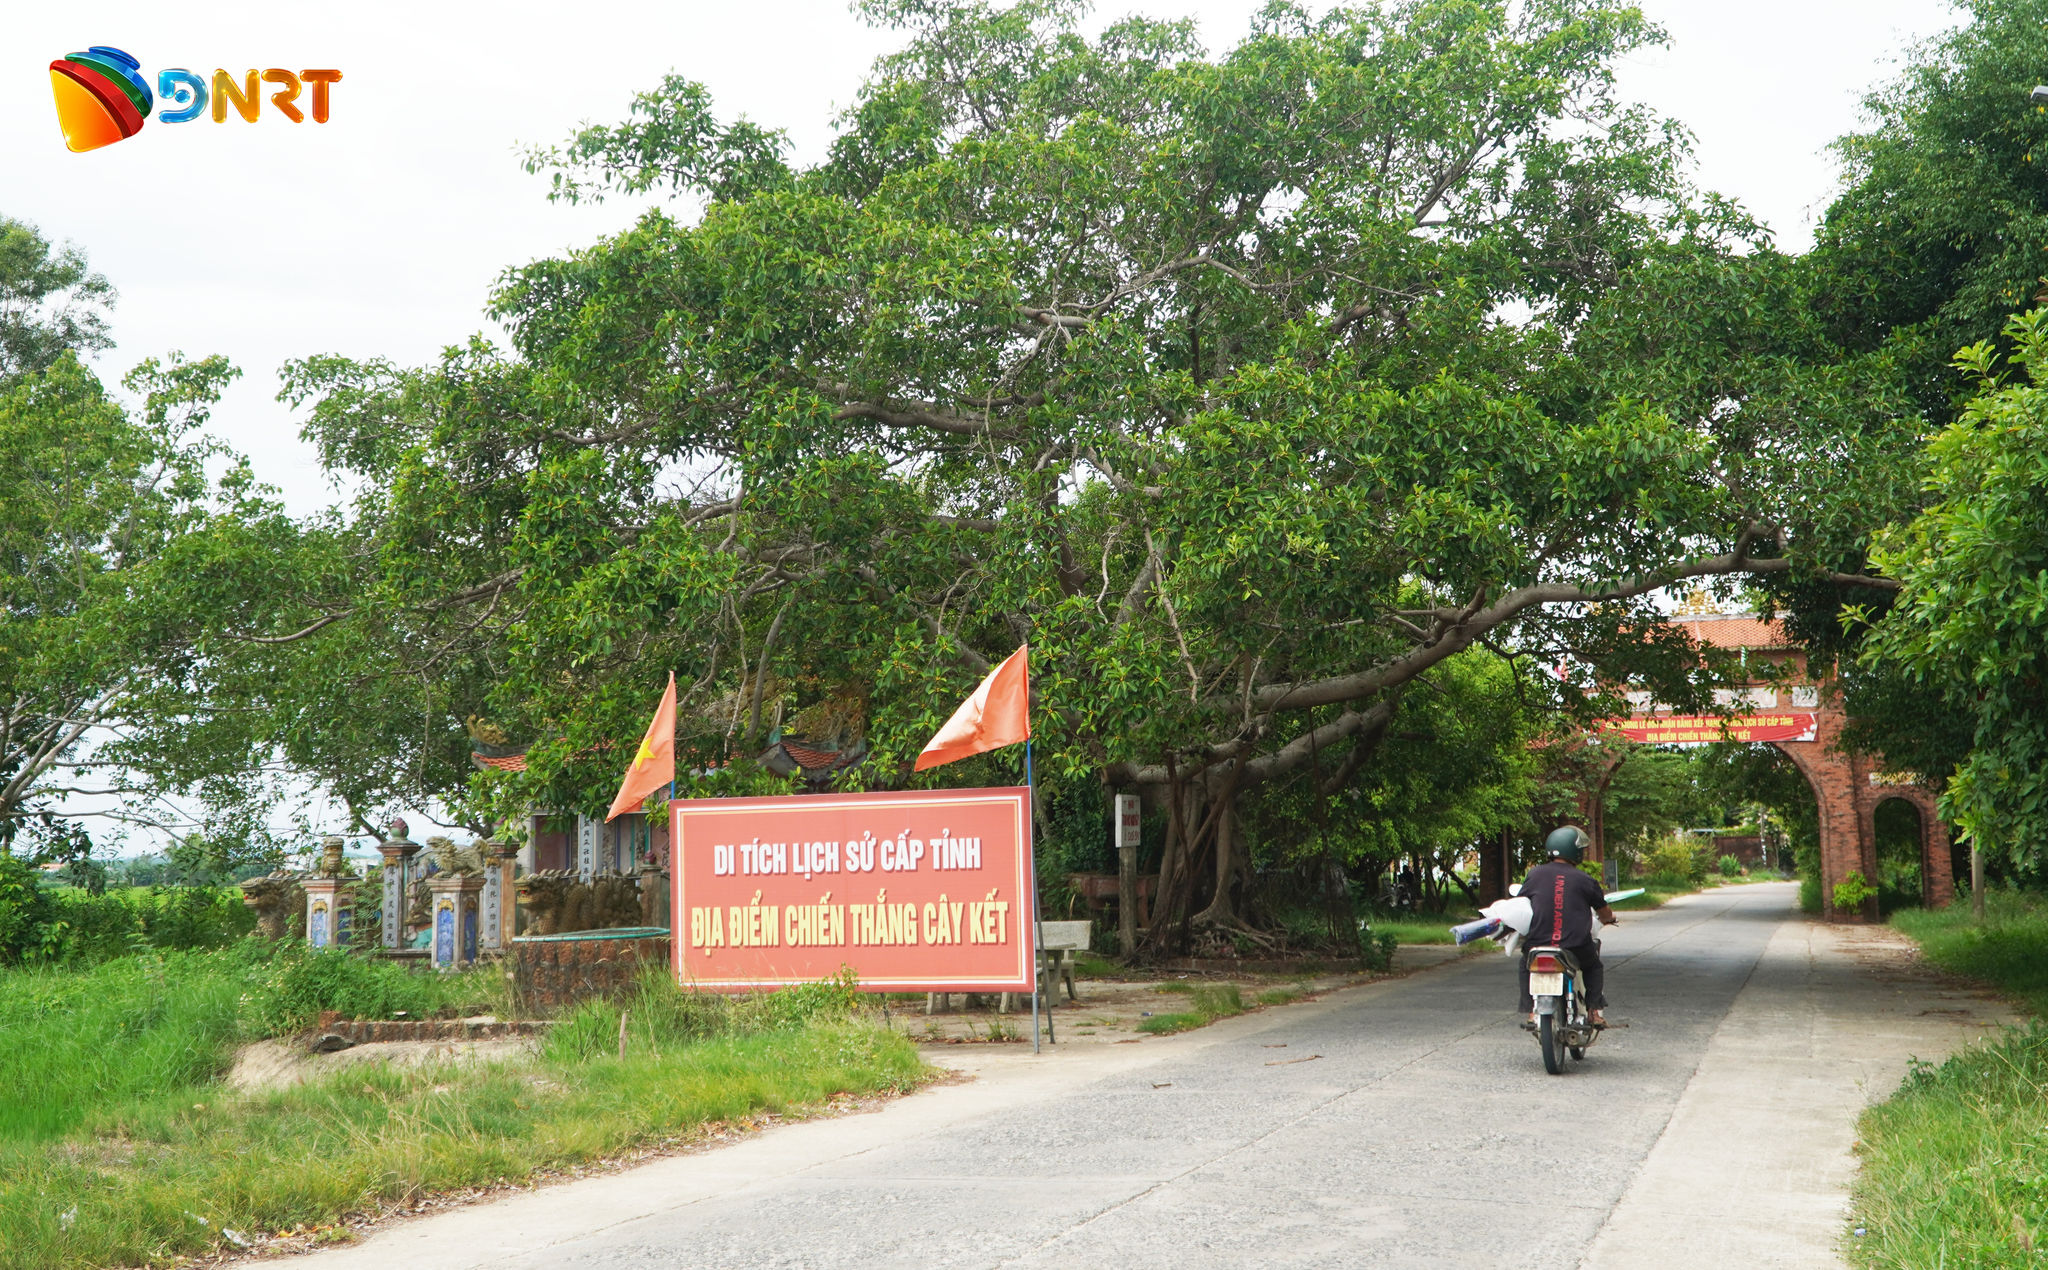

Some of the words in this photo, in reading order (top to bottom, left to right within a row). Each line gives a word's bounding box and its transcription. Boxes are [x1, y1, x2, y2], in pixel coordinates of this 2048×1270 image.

[1677, 730, 1698, 741] CHIẾN
[1738, 728, 1751, 740] KẾT
[1743, 717, 1756, 729] LỊCH
[714, 844, 735, 875] DI
[740, 837, 787, 875] TÍCH
[792, 841, 840, 880] LỊCH
[845, 830, 877, 872] SỬ
[880, 828, 925, 872] CẤP
[929, 828, 981, 870] TỈNH
[1554, 875, 1565, 910] UNDER
[691, 906, 725, 956] ĐỊA
[729, 889, 780, 947] ĐIỂM
[785, 891, 845, 947] CHIẾN
[849, 888, 918, 945] THẮNG
[923, 893, 965, 945] CÂY
[969, 888, 1009, 944] KẾT
